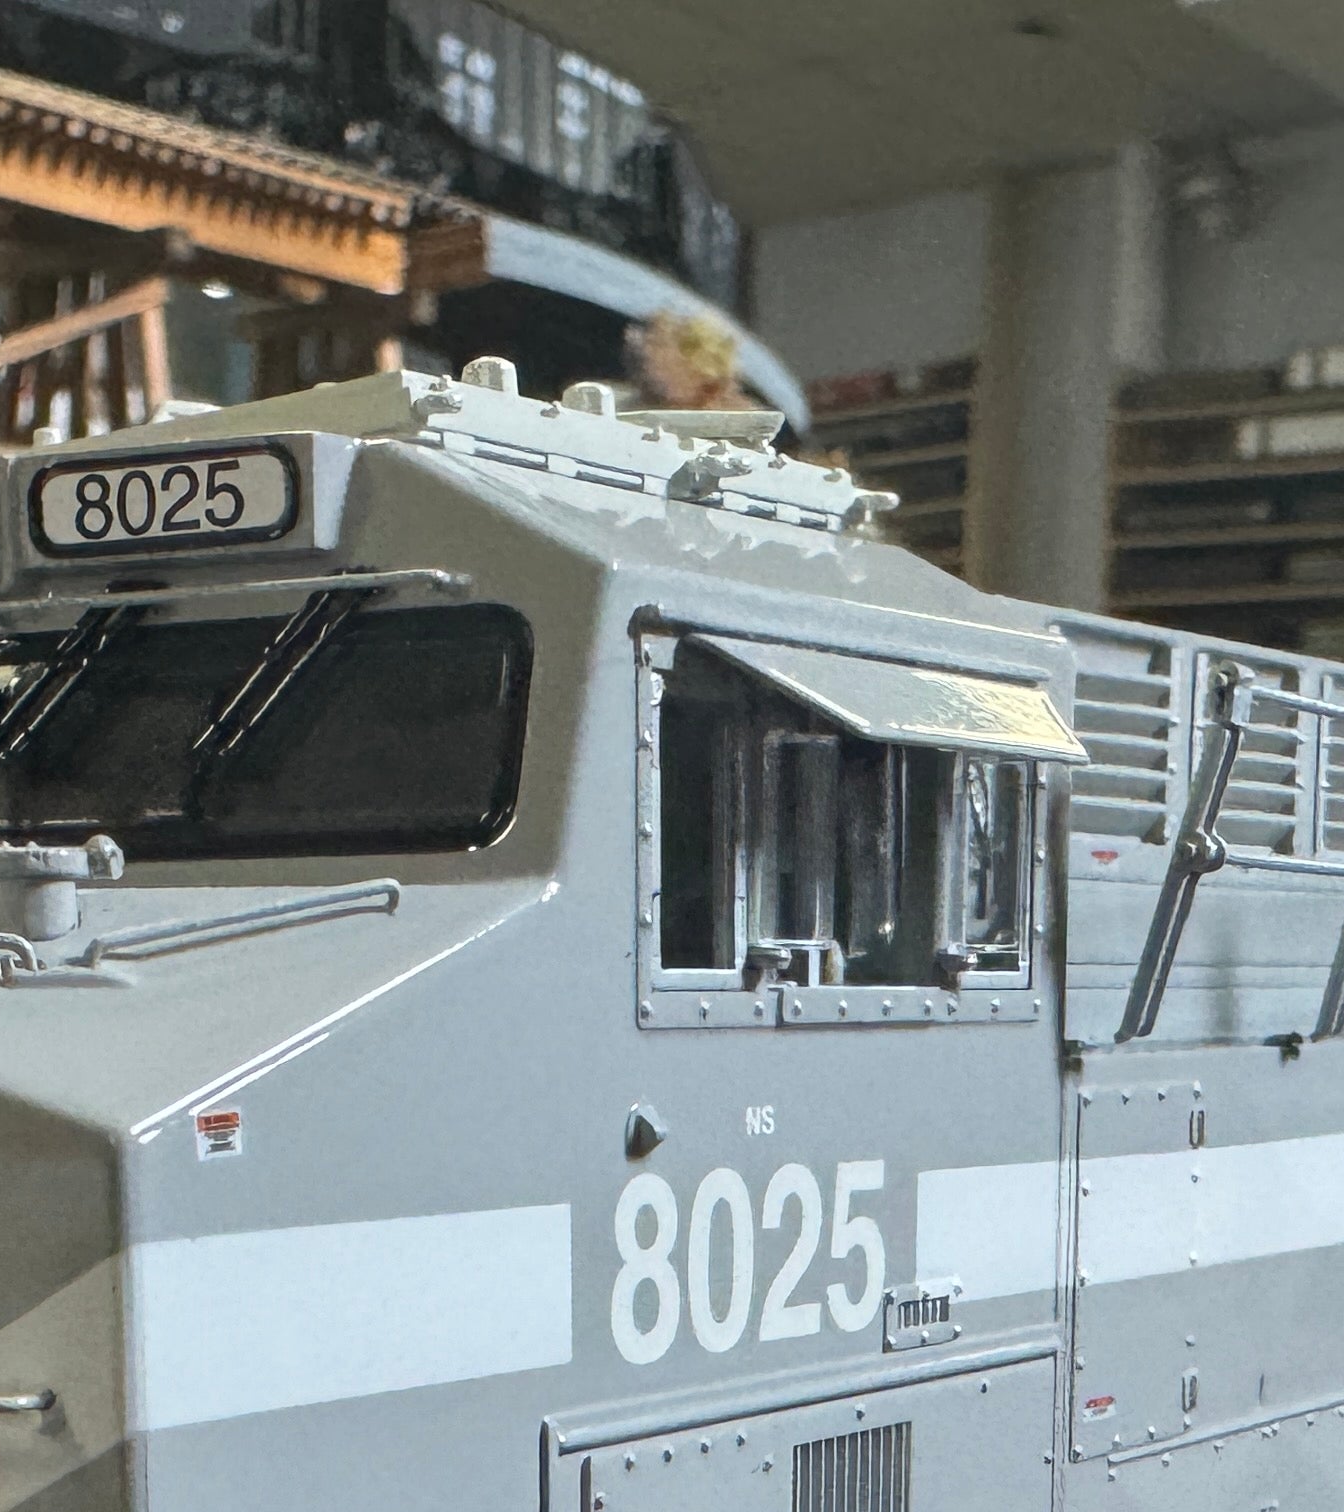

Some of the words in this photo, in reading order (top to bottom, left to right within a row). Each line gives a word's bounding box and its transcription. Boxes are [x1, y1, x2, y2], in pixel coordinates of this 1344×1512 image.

[75, 459, 245, 540] 8025
[745, 1104, 775, 1136] NS
[610, 1160, 885, 1364] 8025
